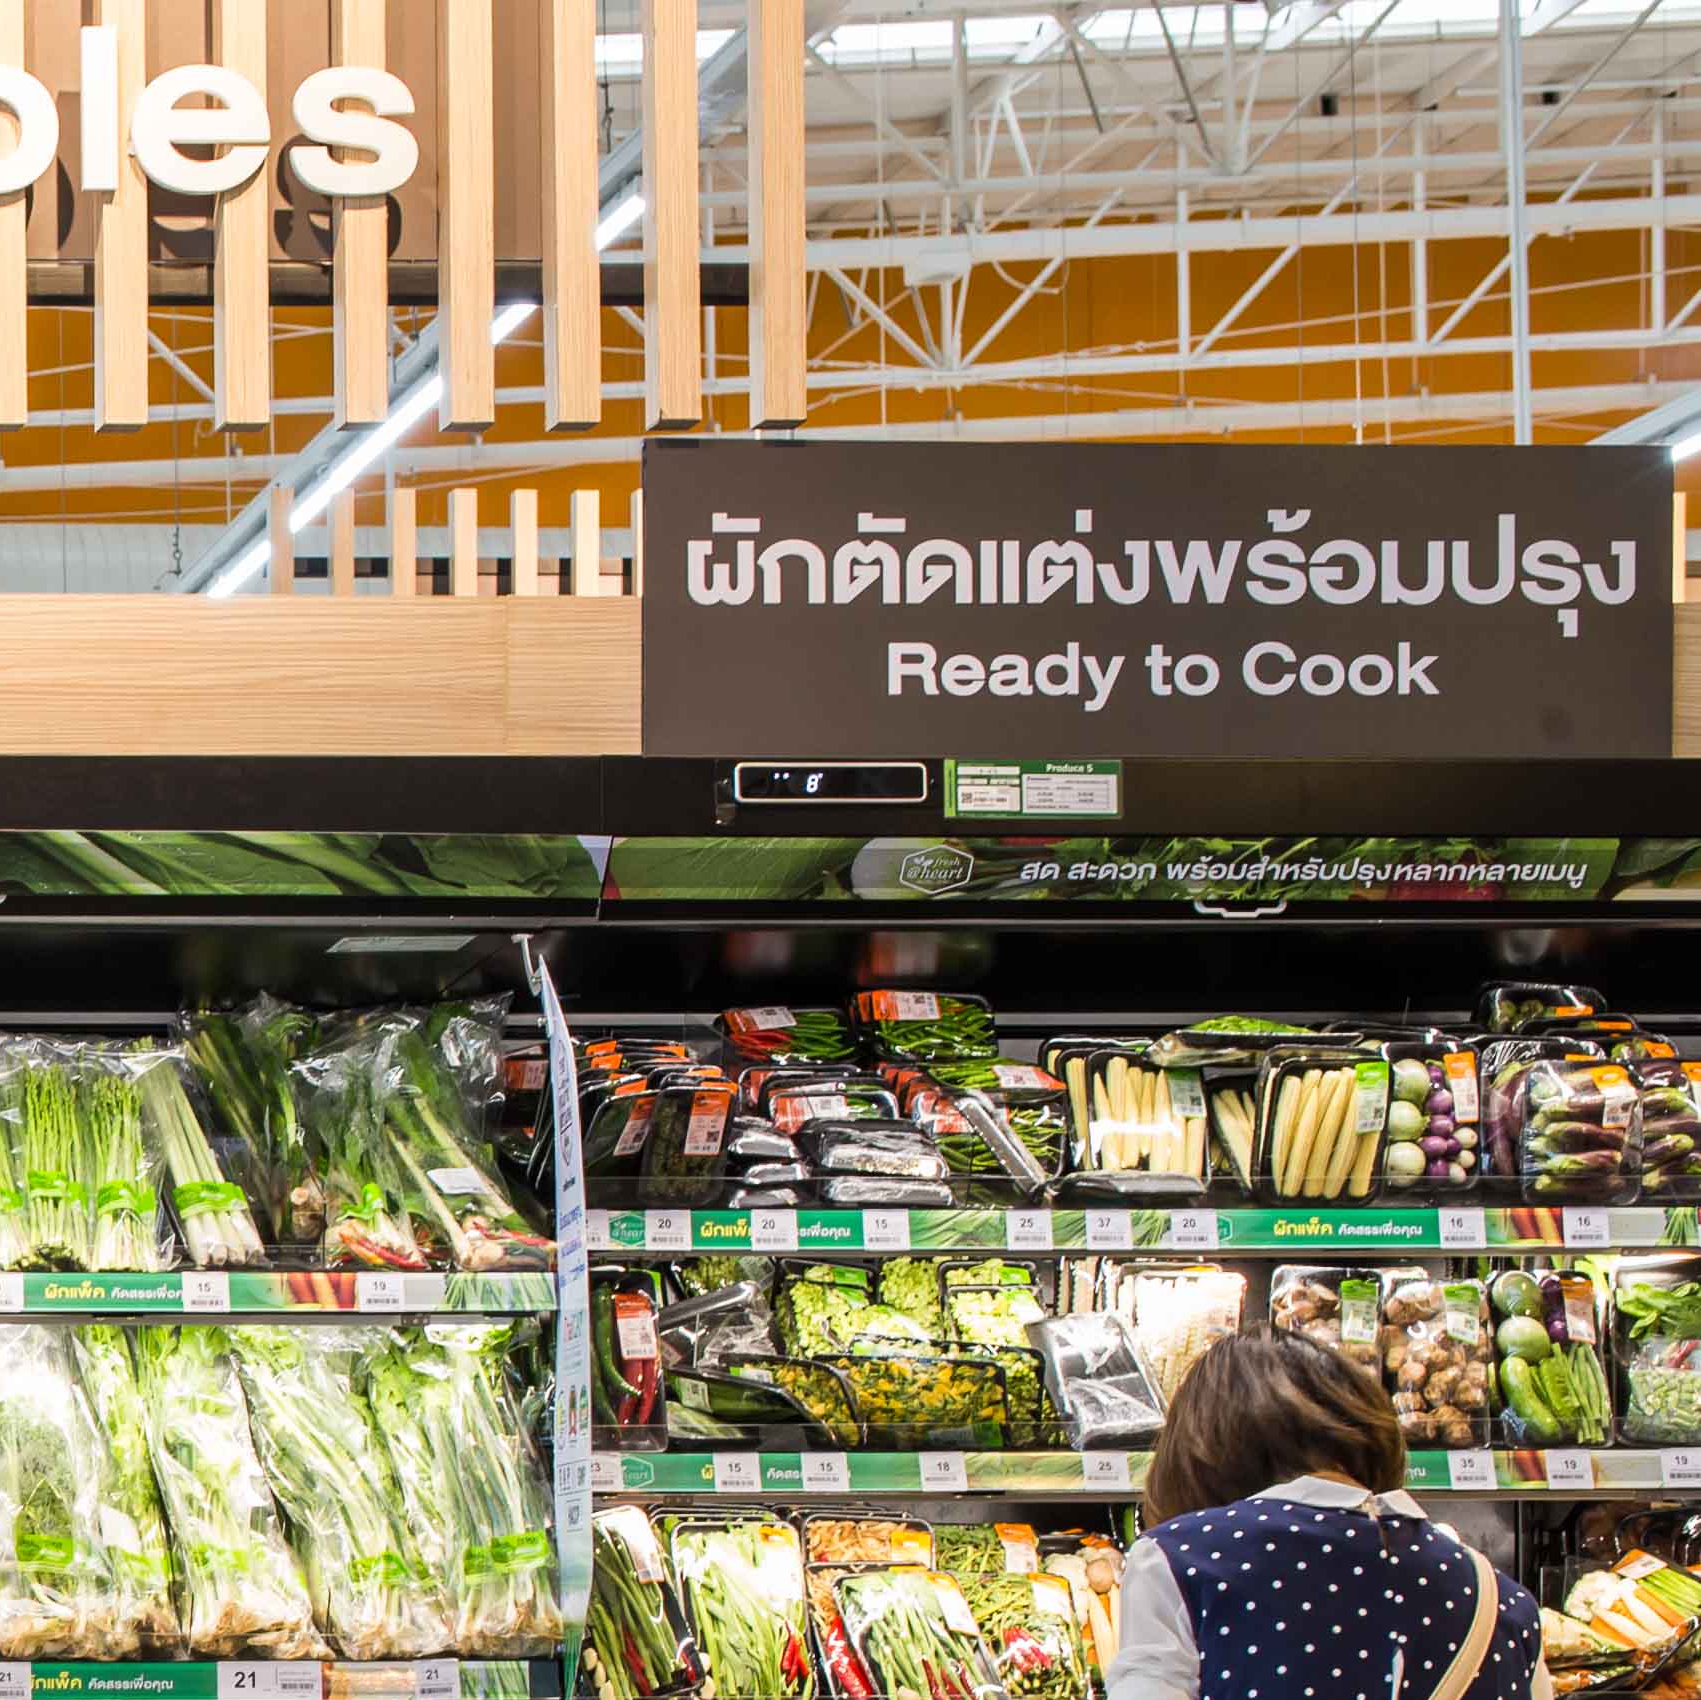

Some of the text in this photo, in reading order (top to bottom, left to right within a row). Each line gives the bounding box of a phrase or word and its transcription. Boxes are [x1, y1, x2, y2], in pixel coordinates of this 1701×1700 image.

[686, 508, 1638, 637] ผักตัดแต่งพร้อมปรุง
[887, 641, 1440, 712] Ready to Cook
[1046, 763, 1083, 773] Produce
[907, 866, 965, 882] @heart
[1020, 862, 1060, 881] สด
[658, 1219, 671, 1228] 20
[762, 1220, 775, 1229] 20
[876, 1219, 887, 1229] 15
[1021, 1218, 1033, 1228] 25
[1183, 1219, 1196, 1228] 20
[1451, 1218, 1463, 1228] 16
[1579, 1216, 1590, 1226] 16
[1273, 1218, 1333, 1236] ผักแพ็ค
[45, 1281, 105, 1299] ผักแพ็ค
[1462, 1458, 1474, 1468] 35
[1565, 1460, 1576, 1469] 19
[1675, 1456, 1687, 1464] 19
[729, 1463, 741, 1472] 15
[820, 1463, 832, 1471] 15
[937, 1462, 950, 1471] 18
[1099, 1462, 1111, 1470] 25
[0, 1672, 11, 1682] 21
[426, 1669, 438, 1680] 21
[235, 1672, 255, 1688] 21
